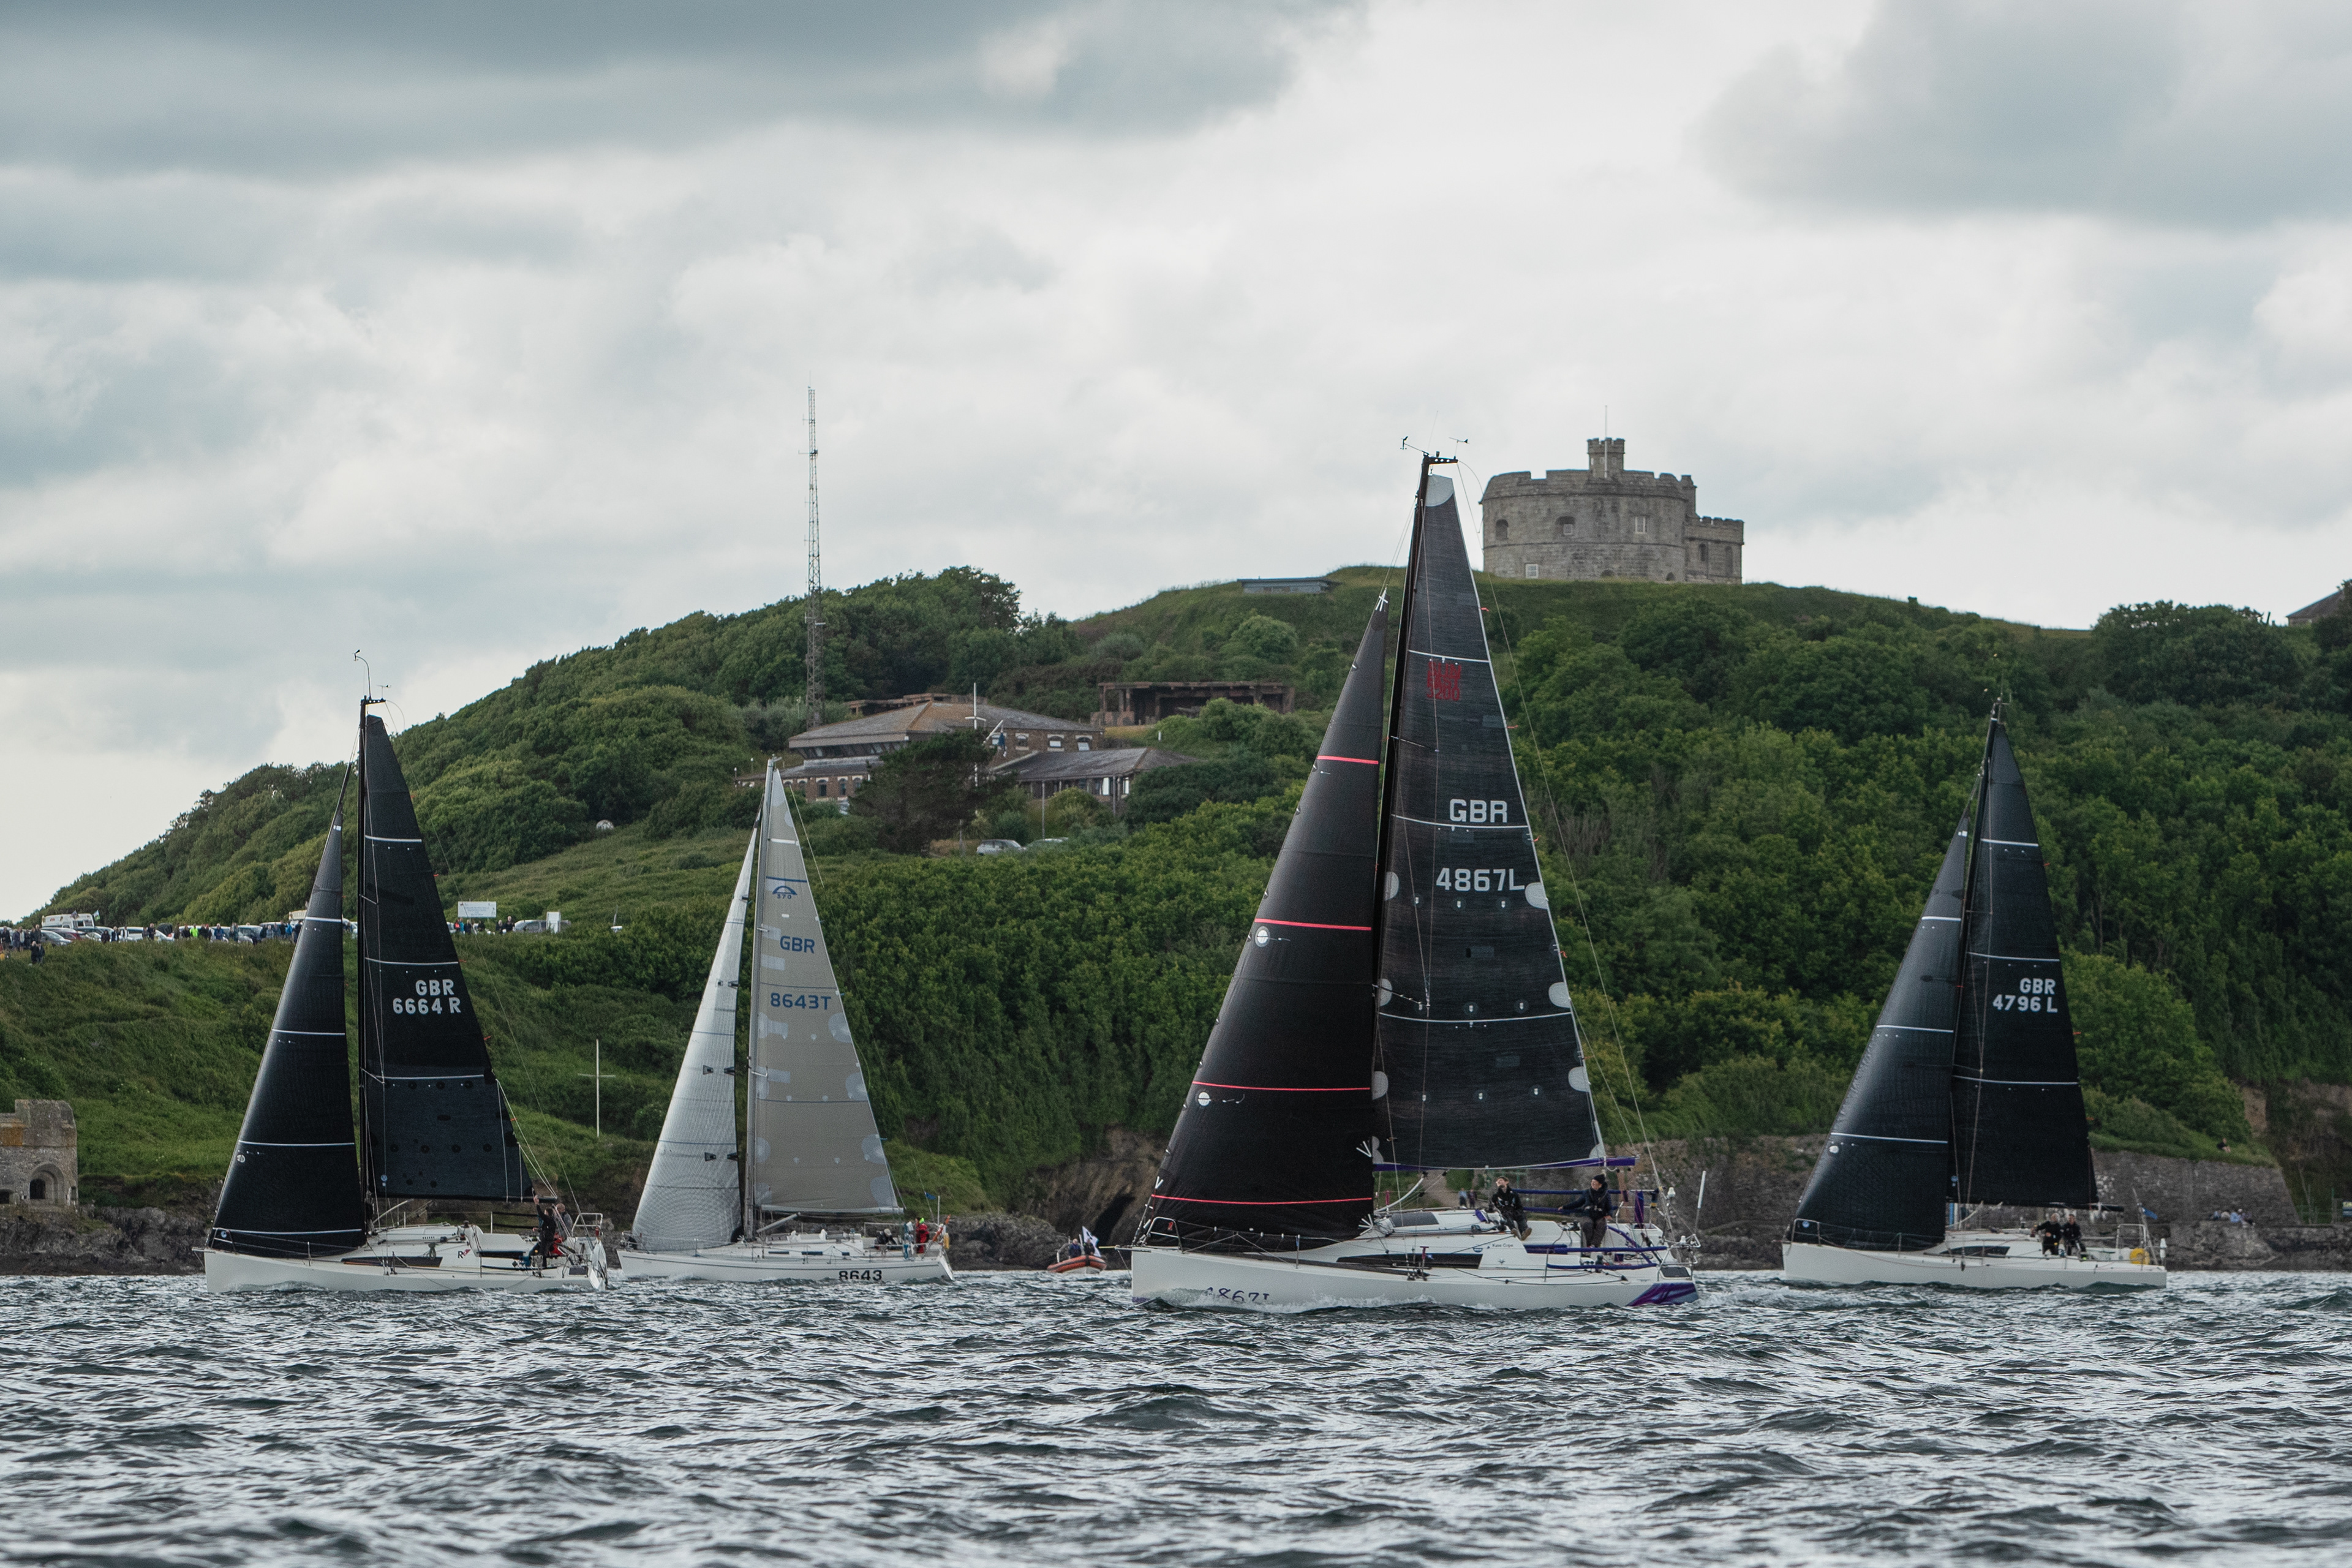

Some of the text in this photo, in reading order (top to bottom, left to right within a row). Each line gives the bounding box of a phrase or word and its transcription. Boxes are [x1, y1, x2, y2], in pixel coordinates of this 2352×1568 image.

[1449, 798, 1508, 823] GBR
[1436, 867, 1525, 892] 4867L
[780, 935, 816, 954] GBR
[415, 979, 454, 996] GBR
[2019, 977, 2056, 995] GBR
[770, 992, 832, 1011] 8643T
[839, 1270, 882, 1281] 8643
